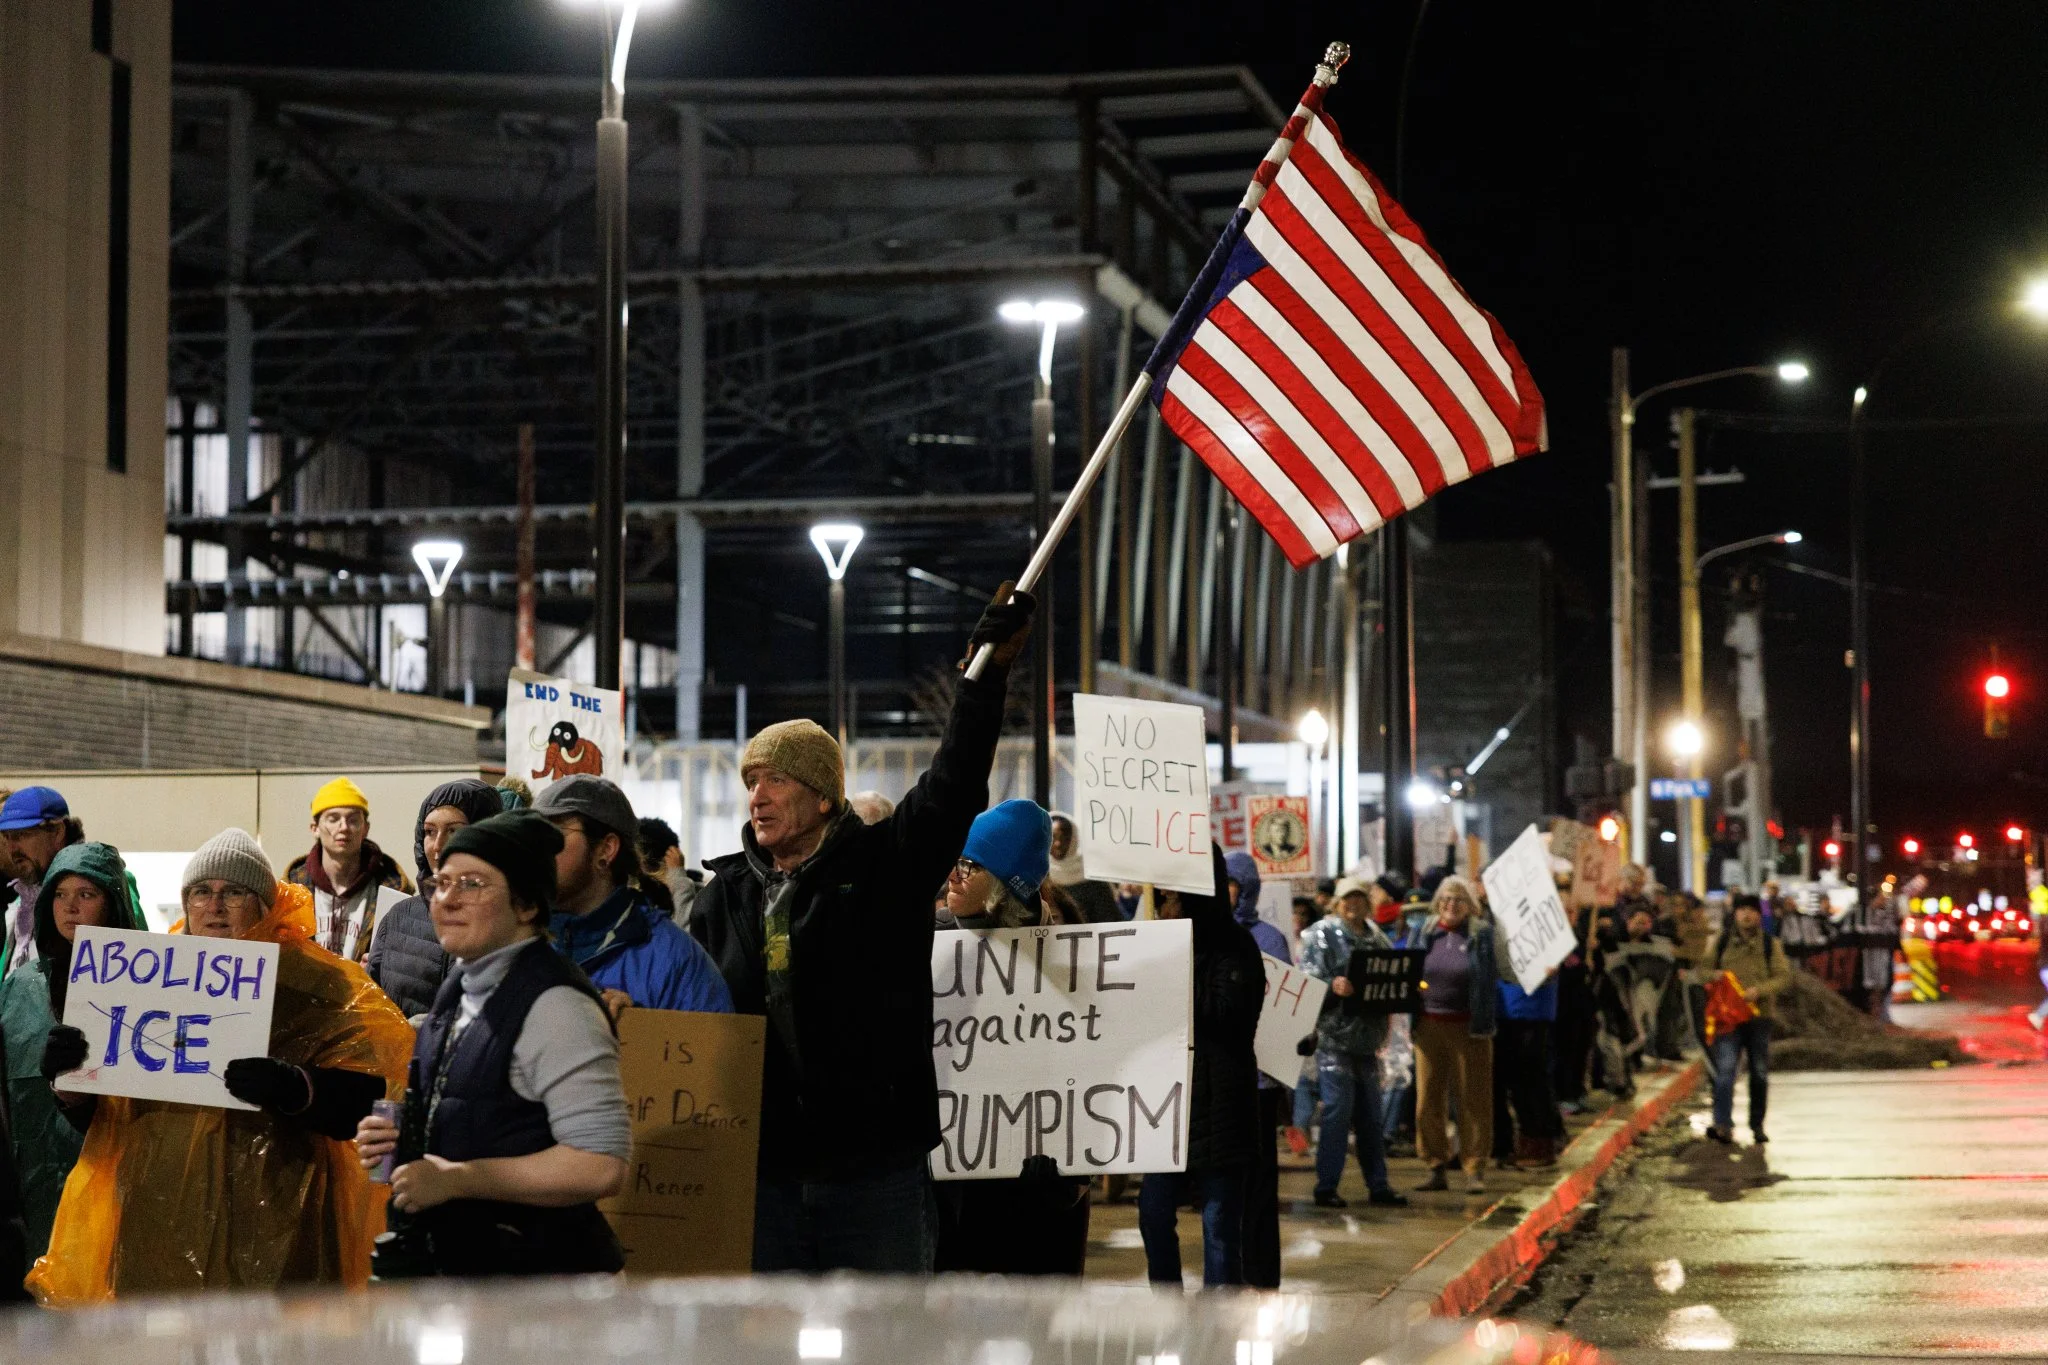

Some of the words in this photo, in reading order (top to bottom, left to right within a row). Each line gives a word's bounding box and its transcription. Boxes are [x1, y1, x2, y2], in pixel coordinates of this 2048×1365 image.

[525, 683, 559, 702] END
[570, 692, 602, 713] THE
[1104, 714, 1156, 750] NO
[1084, 751, 1197, 796] SECRET
[1089, 800, 1207, 854] POLICE
[70, 939, 266, 1001] ABOLISH
[932, 929, 1136, 997] UNITE
[103, 1005, 212, 1073] ICE
[933, 1003, 1102, 1072] against
[672, 1088, 749, 1129] Defence
[635, 1162, 705, 1196] Renee
